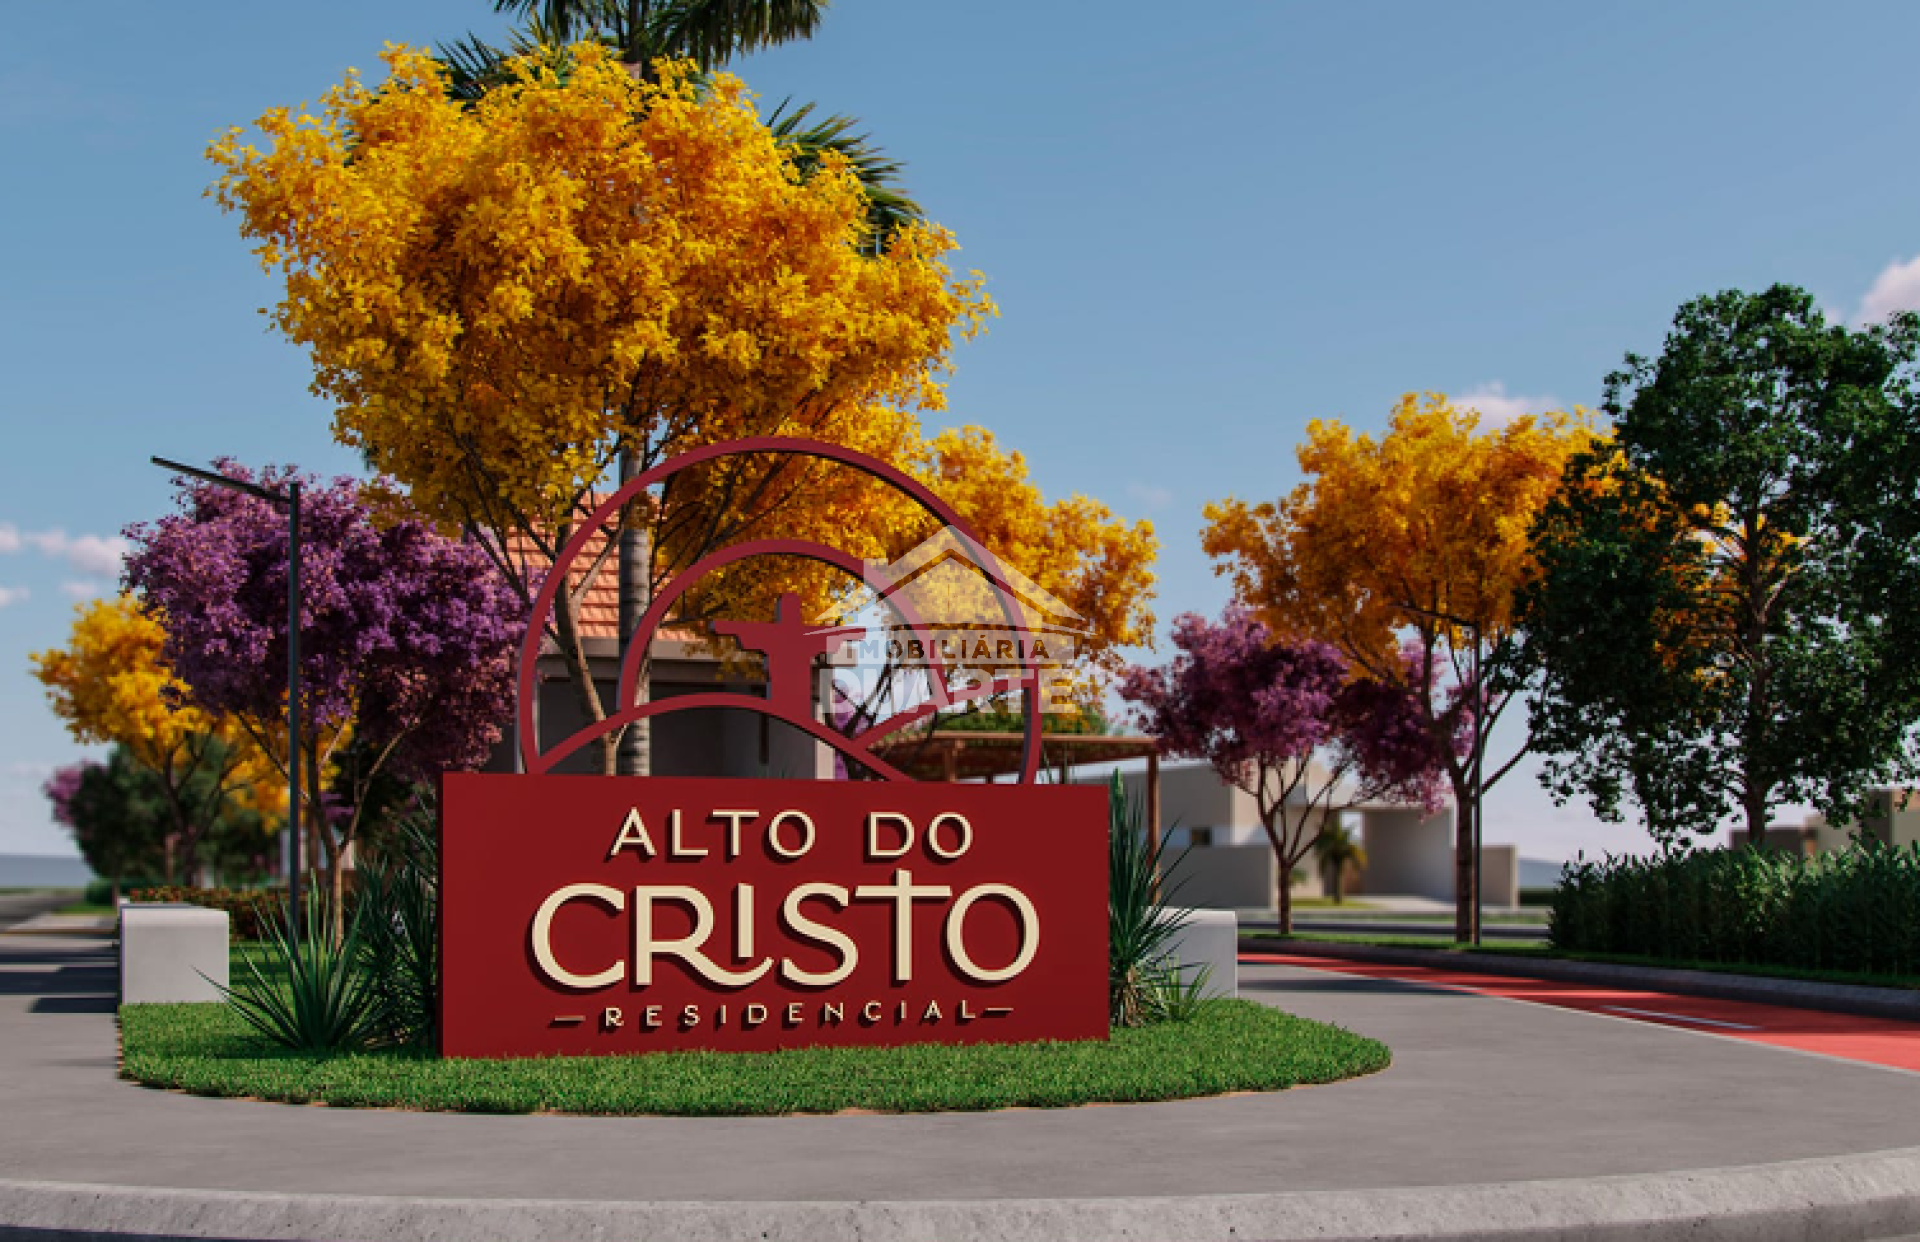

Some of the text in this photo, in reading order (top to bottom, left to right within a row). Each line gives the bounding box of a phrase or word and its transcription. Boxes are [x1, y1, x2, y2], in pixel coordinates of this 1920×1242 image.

[609, 807, 974, 860] ALTO DO
[530, 868, 1041, 988] CRISTO
[604, 999, 977, 1028] RESIDENCIAL
